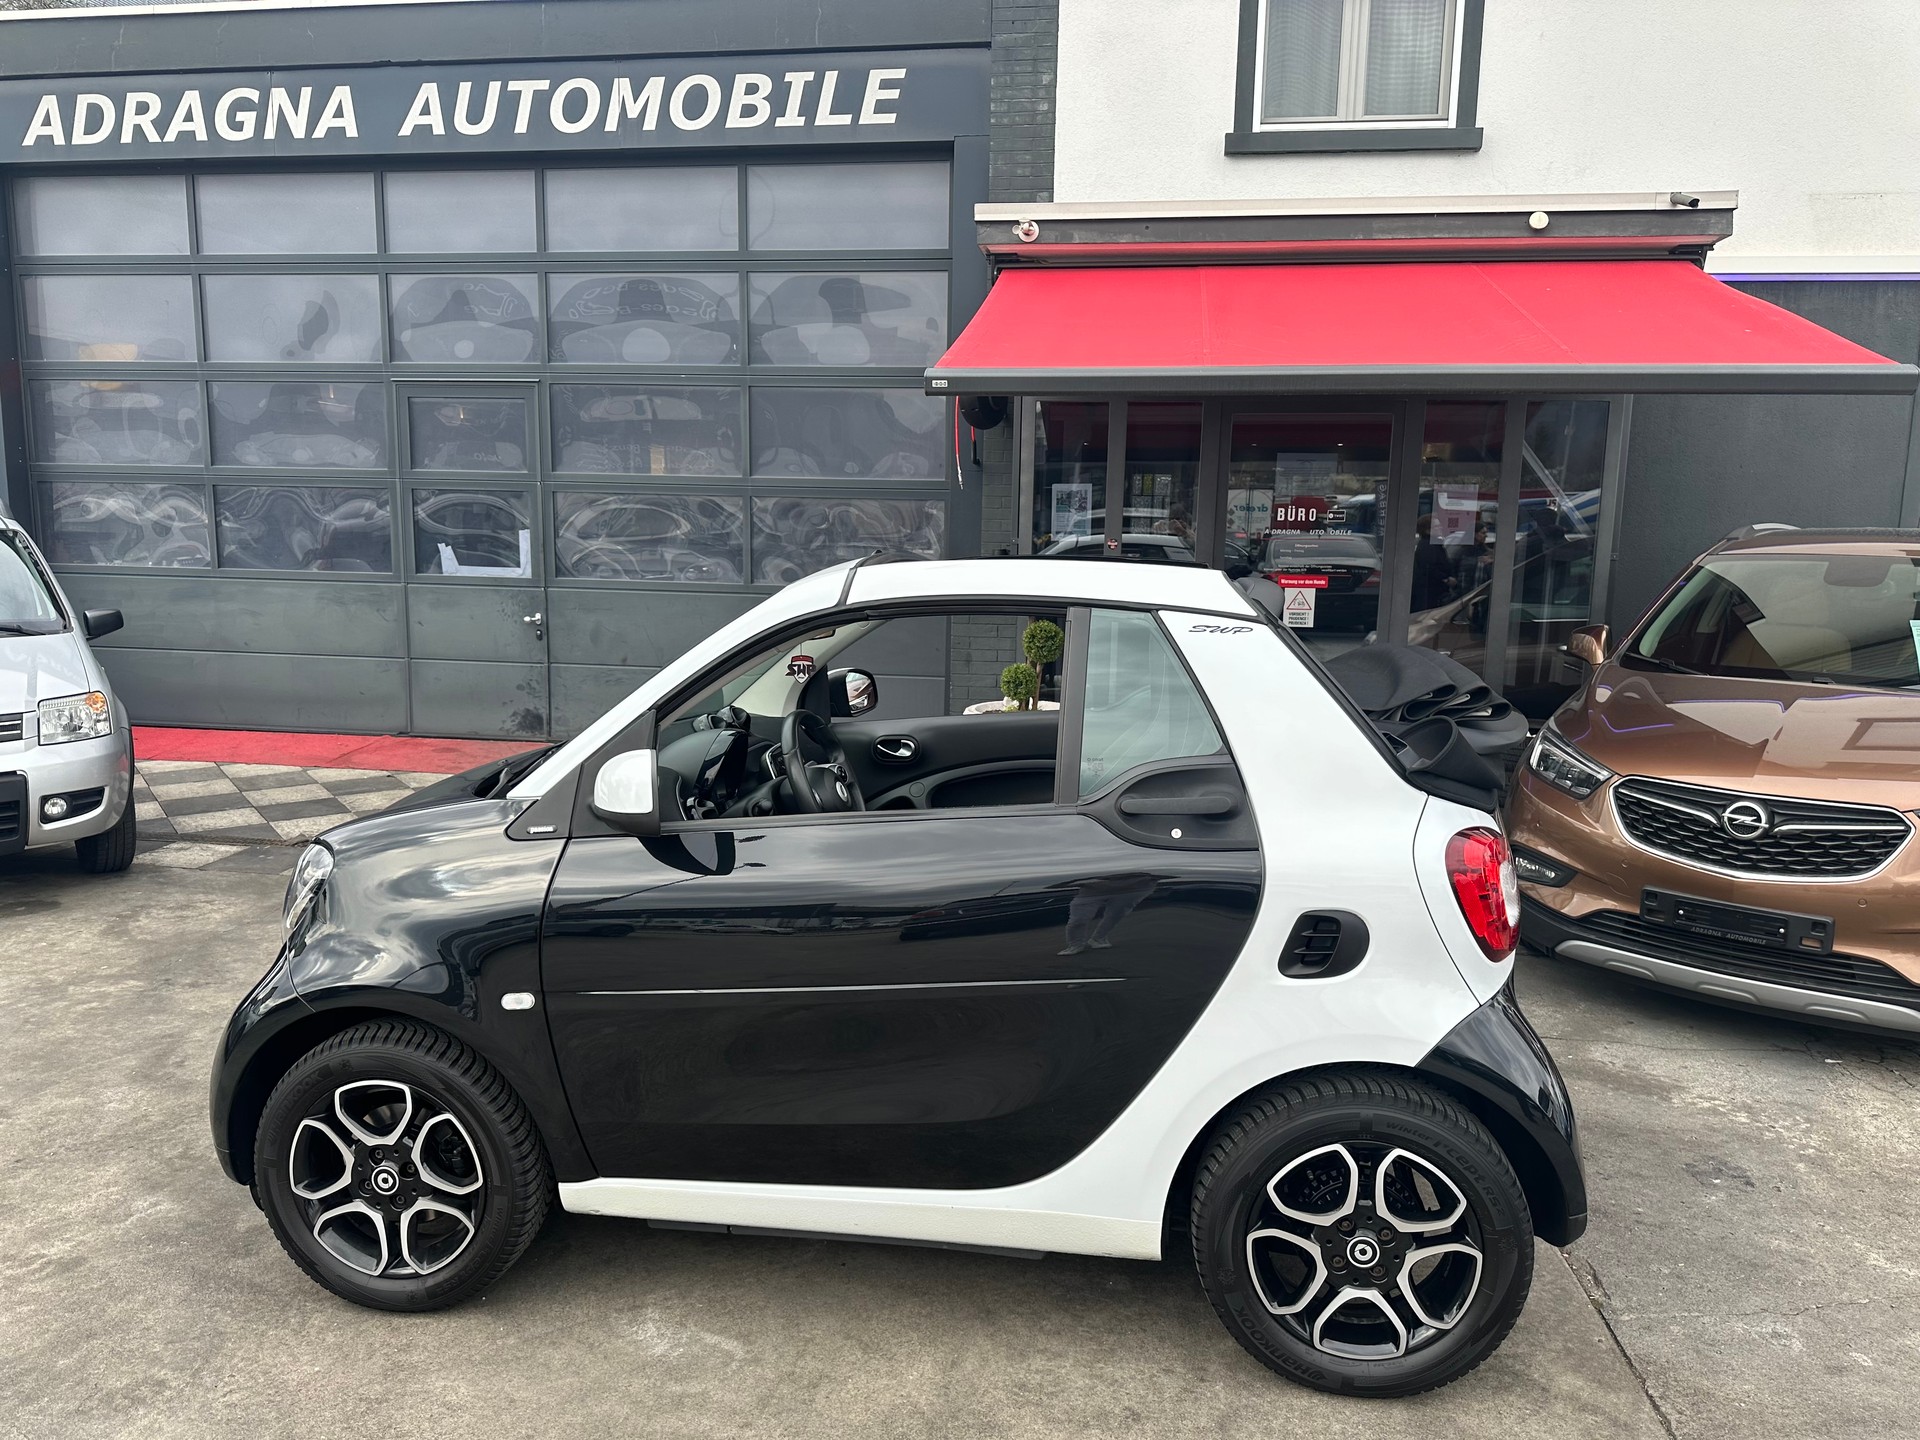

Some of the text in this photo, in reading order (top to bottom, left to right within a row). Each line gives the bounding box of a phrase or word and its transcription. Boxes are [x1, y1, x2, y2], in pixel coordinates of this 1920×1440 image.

[22, 68, 907, 146] ADRAGNA AUTOMOBILE
[1277, 506, 1317, 521] BÜRO
[1188, 625, 1253, 634] SWP
[1690, 926, 1767, 945] ADRAGNA AUTOMOBILE
